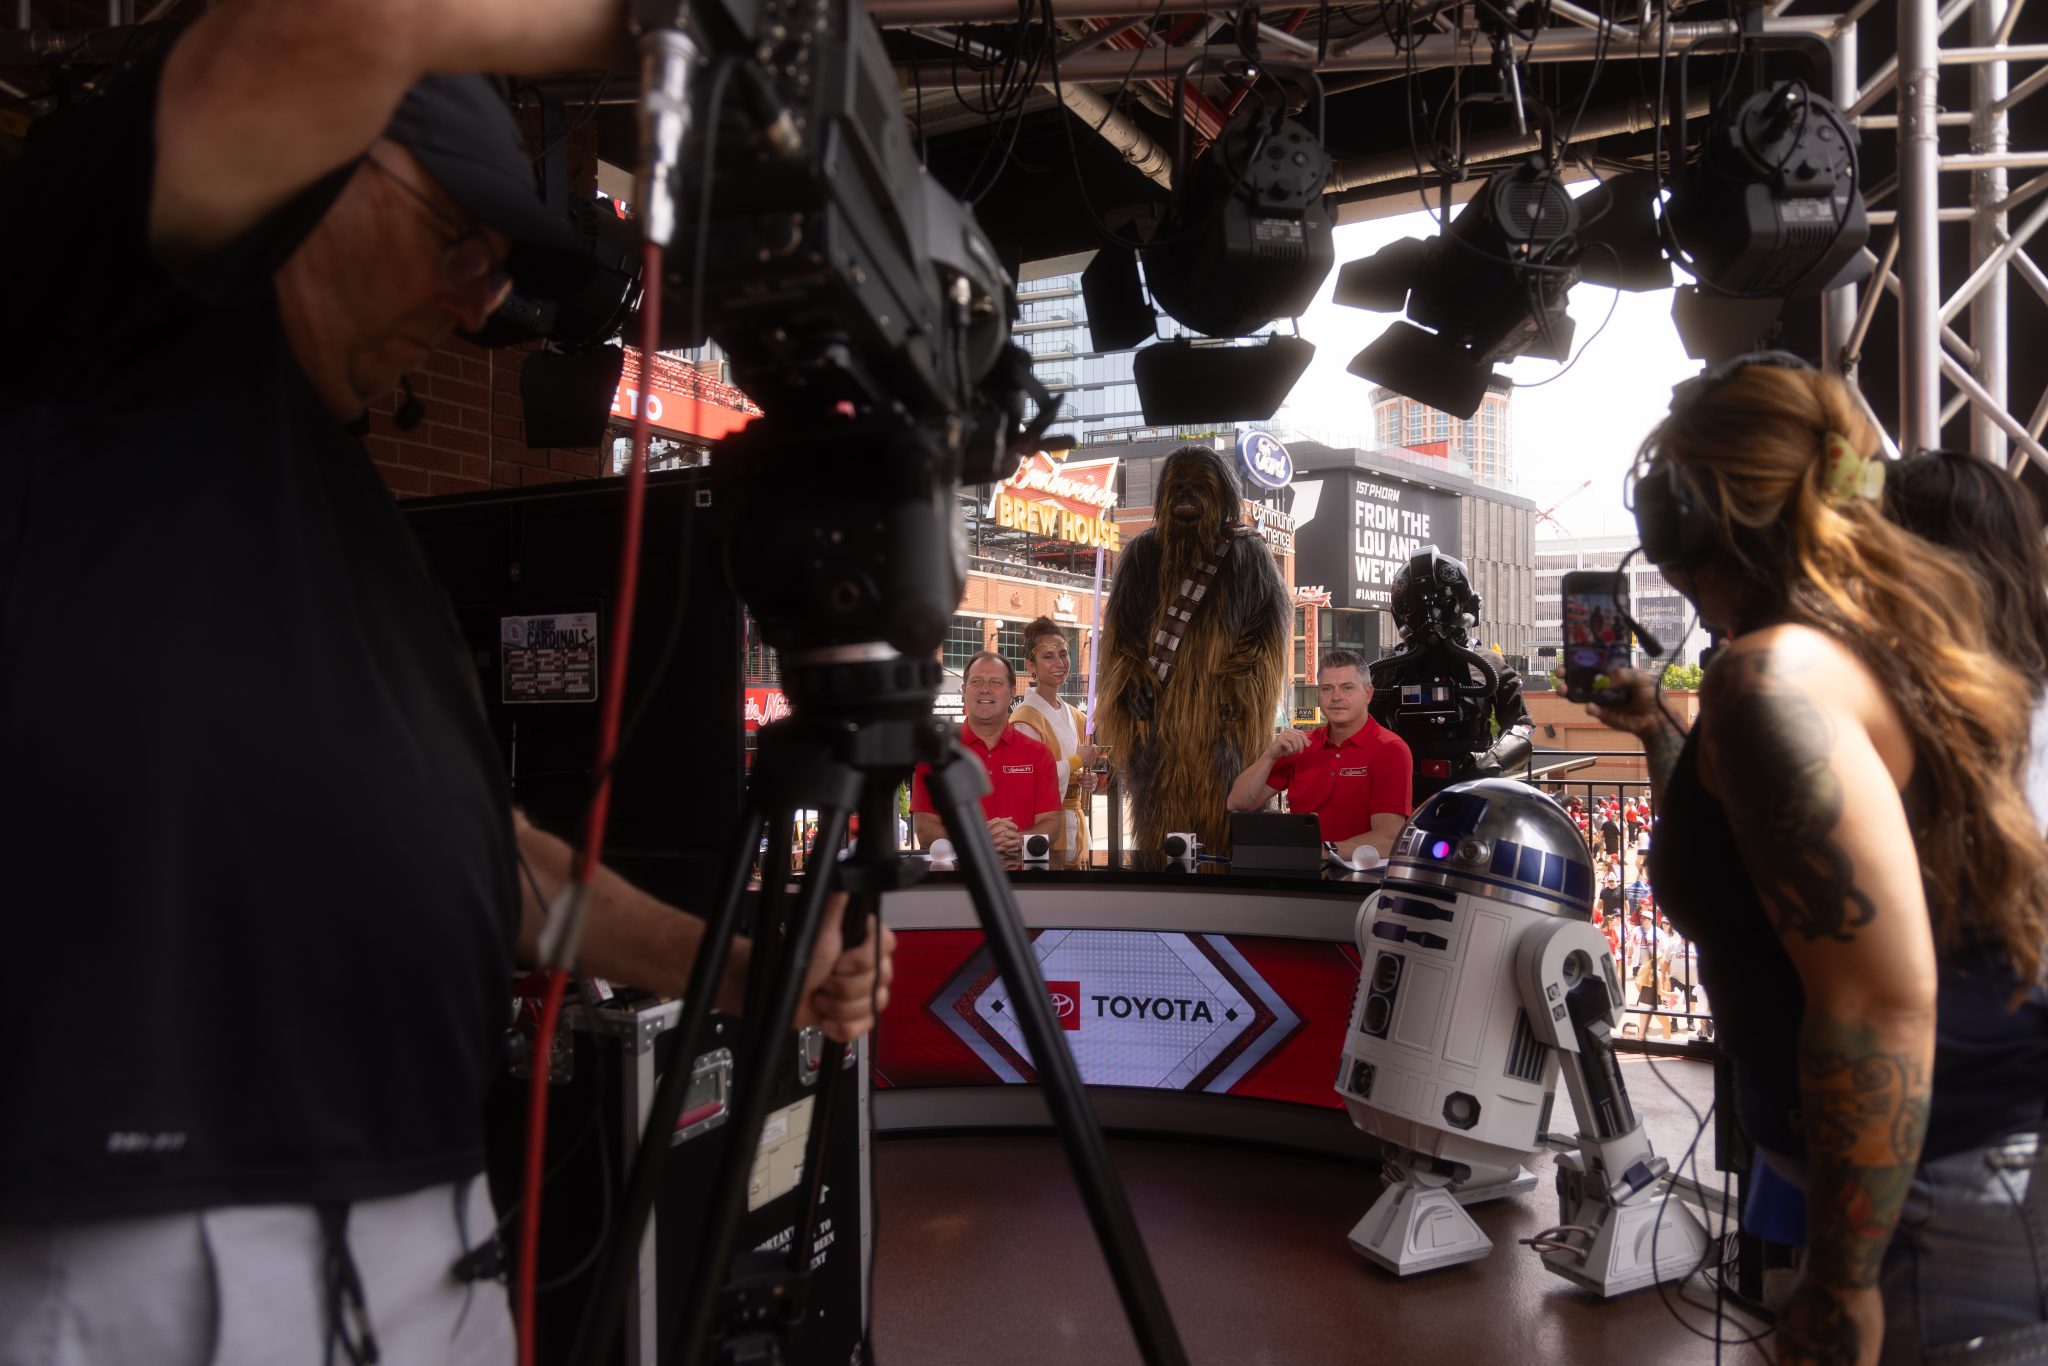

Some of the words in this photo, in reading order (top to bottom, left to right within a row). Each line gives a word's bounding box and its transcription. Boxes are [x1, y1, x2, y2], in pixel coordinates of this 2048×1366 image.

[626, 388, 663, 421] TO
[1255, 438, 1287, 479] Ford
[1356, 480, 1369, 495] 1ST
[1369, 482, 1400, 502] PHORM
[997, 494, 1057, 537] BREW
[1059, 510, 1120, 551] HOUSE
[1252, 501, 1295, 534] Community
[1356, 500, 1398, 532] FROM
[1402, 510, 1430, 538] THE
[1356, 528, 1385, 557] LOU
[1355, 556, 1403, 585] WE'R
[1643, 605, 1677, 614] Gateway
[527, 628, 589, 649] CARDINALS
[1643, 622, 1673, 631] Parking
[1091, 996, 1213, 1023] TOYOTA
